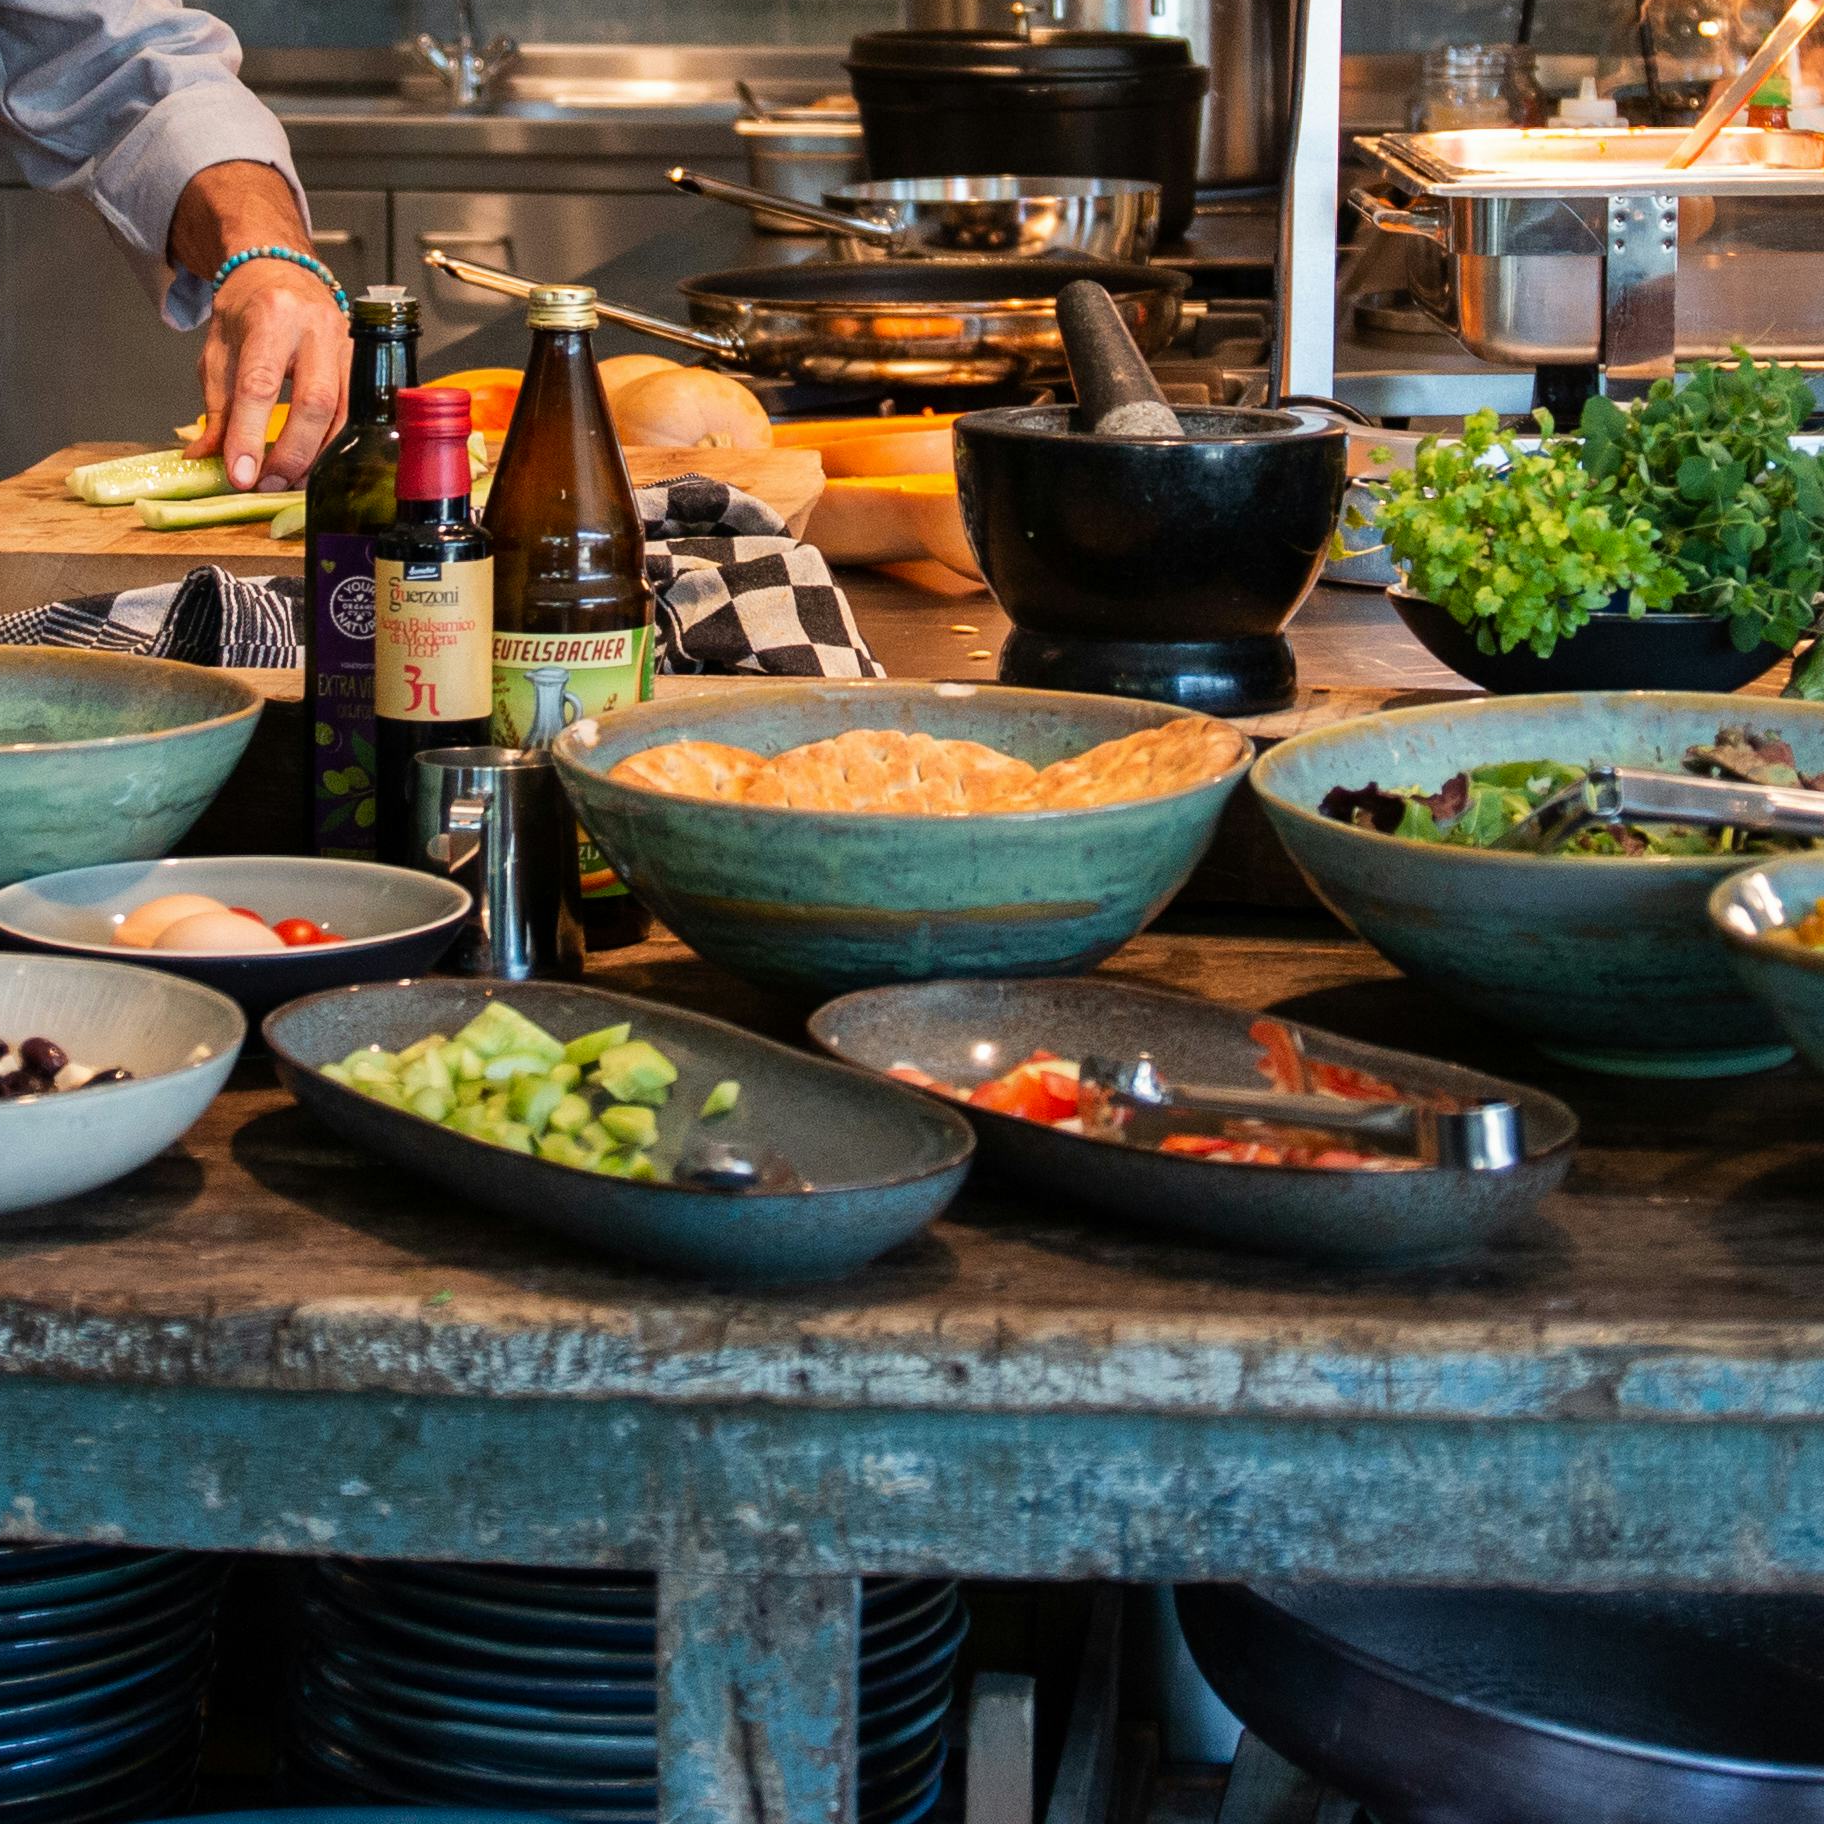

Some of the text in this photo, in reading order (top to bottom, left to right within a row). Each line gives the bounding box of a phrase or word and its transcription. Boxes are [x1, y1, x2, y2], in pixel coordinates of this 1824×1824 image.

[336, 612, 376, 634] NATUR
[409, 617, 475, 632] Balsamico
[493, 637, 625, 663] EUTELSBACHER
